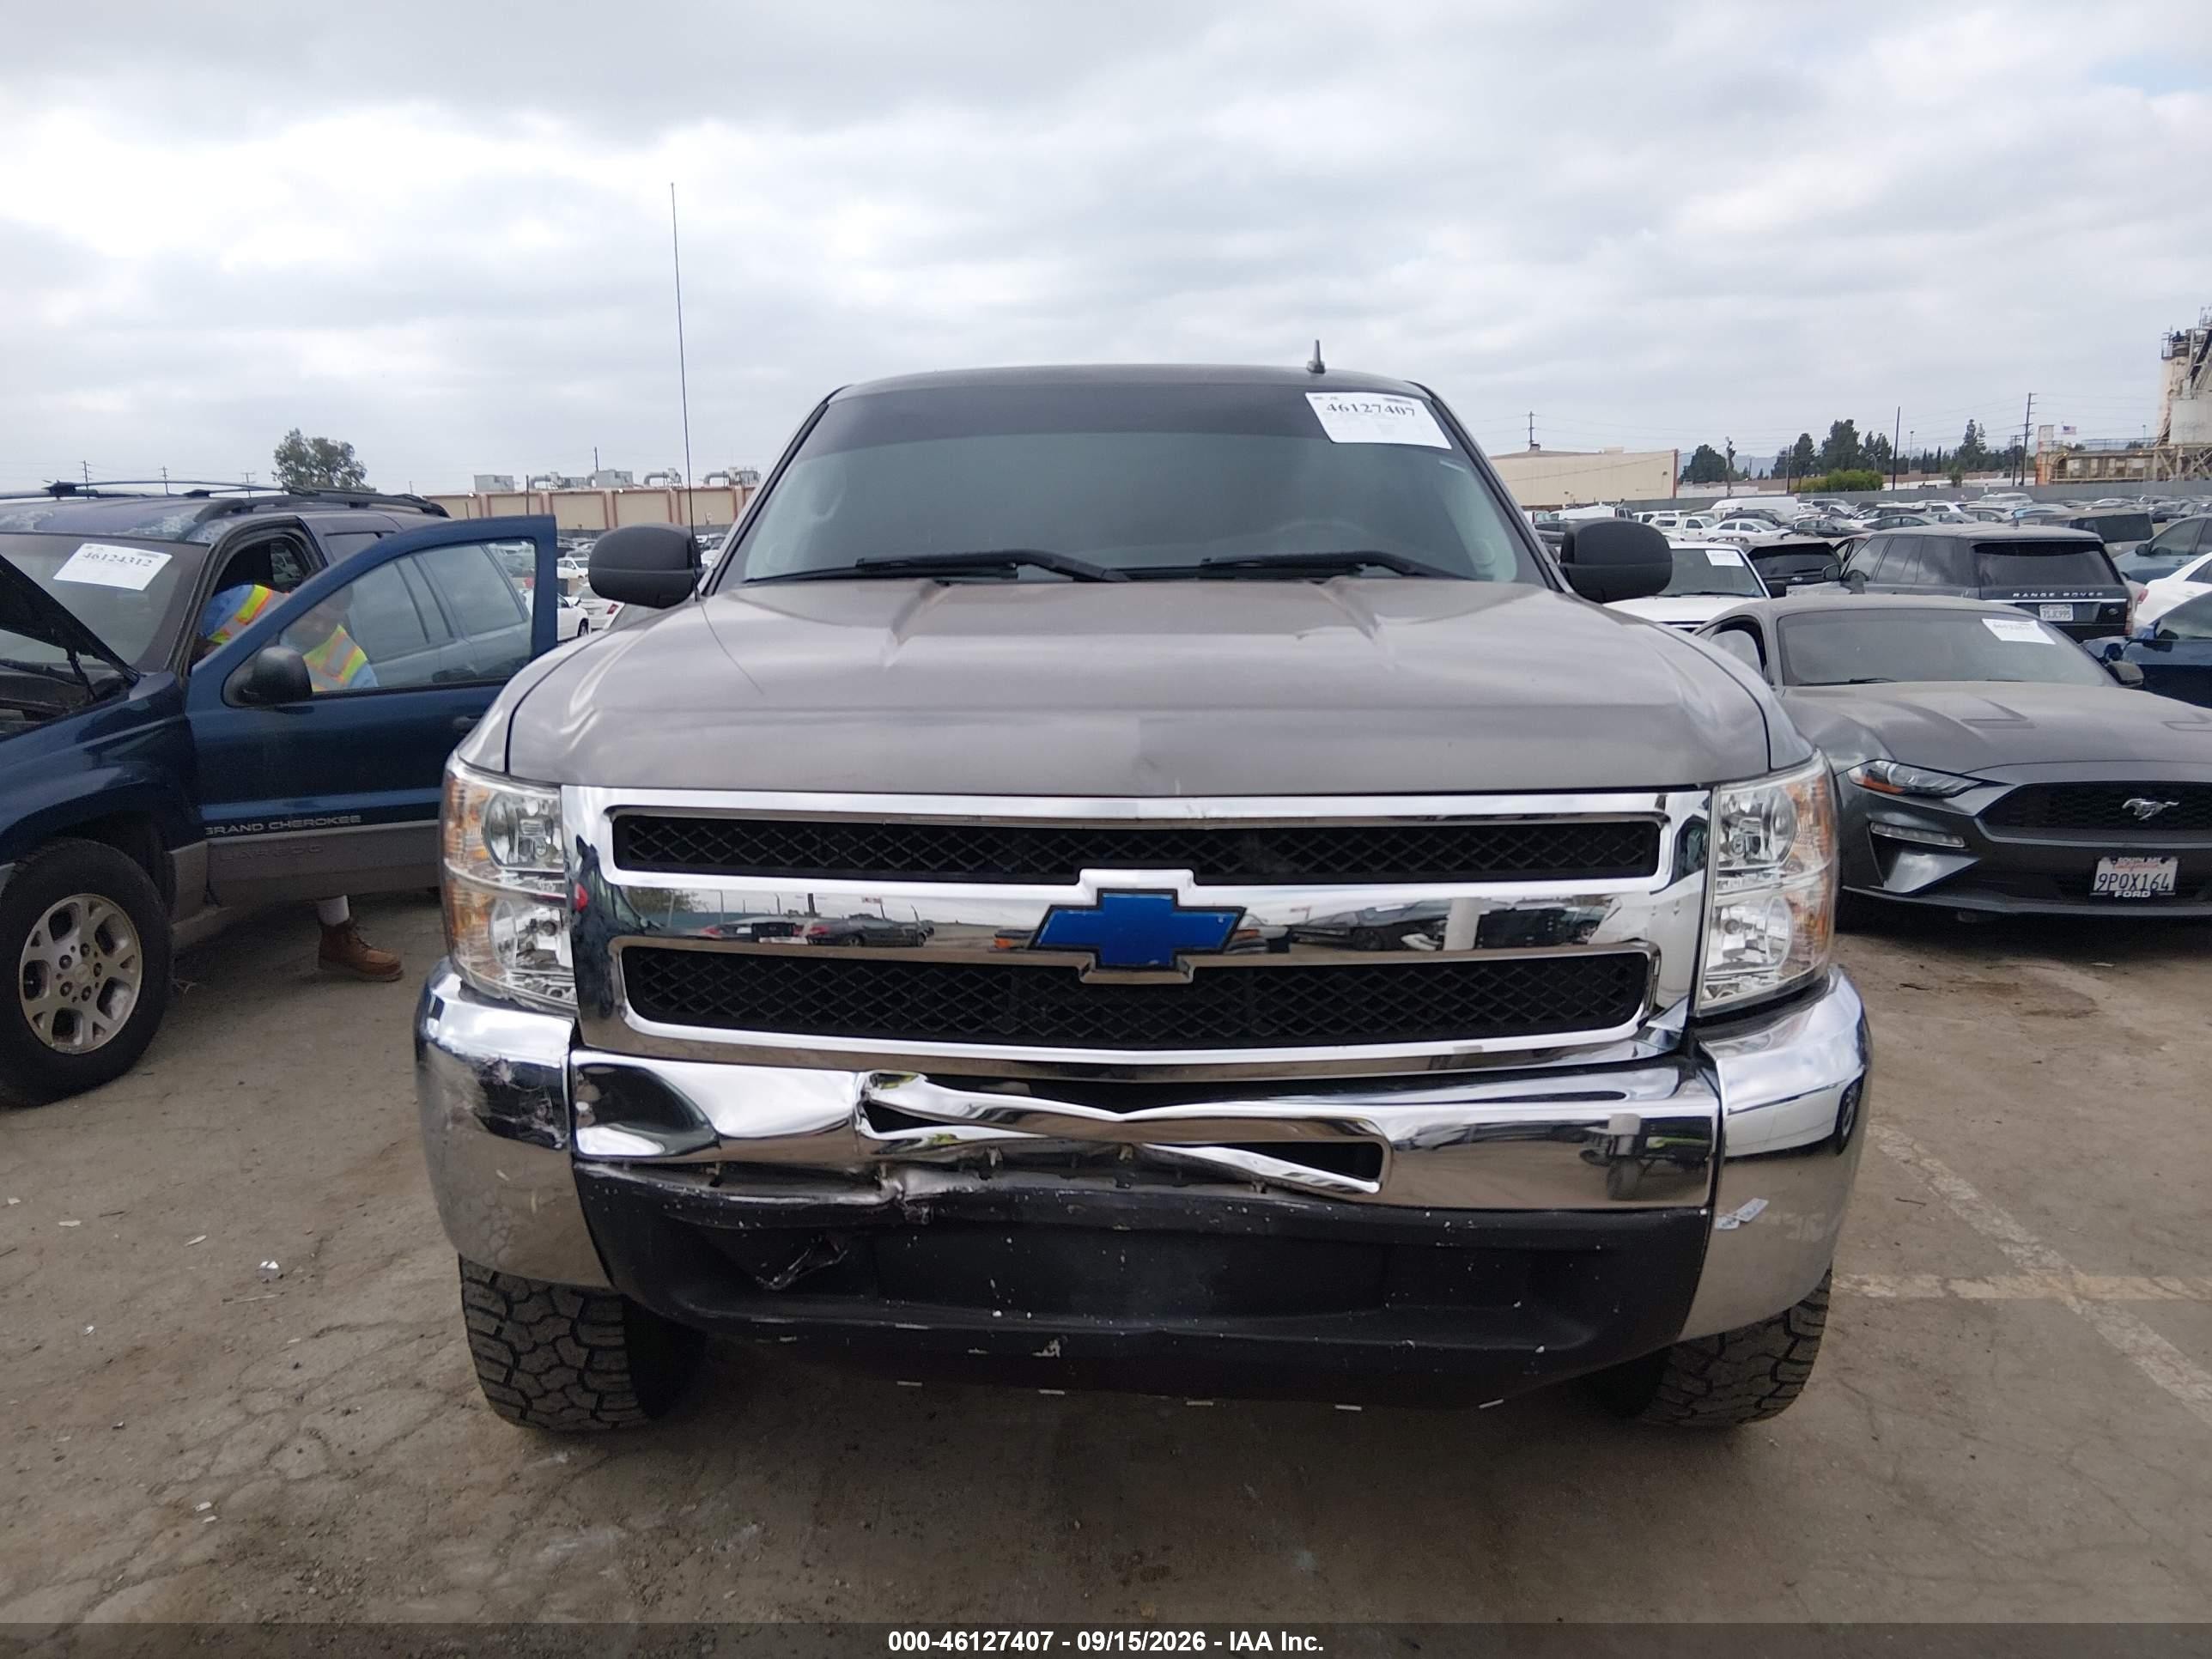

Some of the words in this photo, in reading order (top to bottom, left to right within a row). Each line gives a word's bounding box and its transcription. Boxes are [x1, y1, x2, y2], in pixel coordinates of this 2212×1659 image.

[1327, 403, 1415, 416] 46127407
[82, 551, 153, 568] 46124312
[268, 814, 362, 830] CHEROKEE
